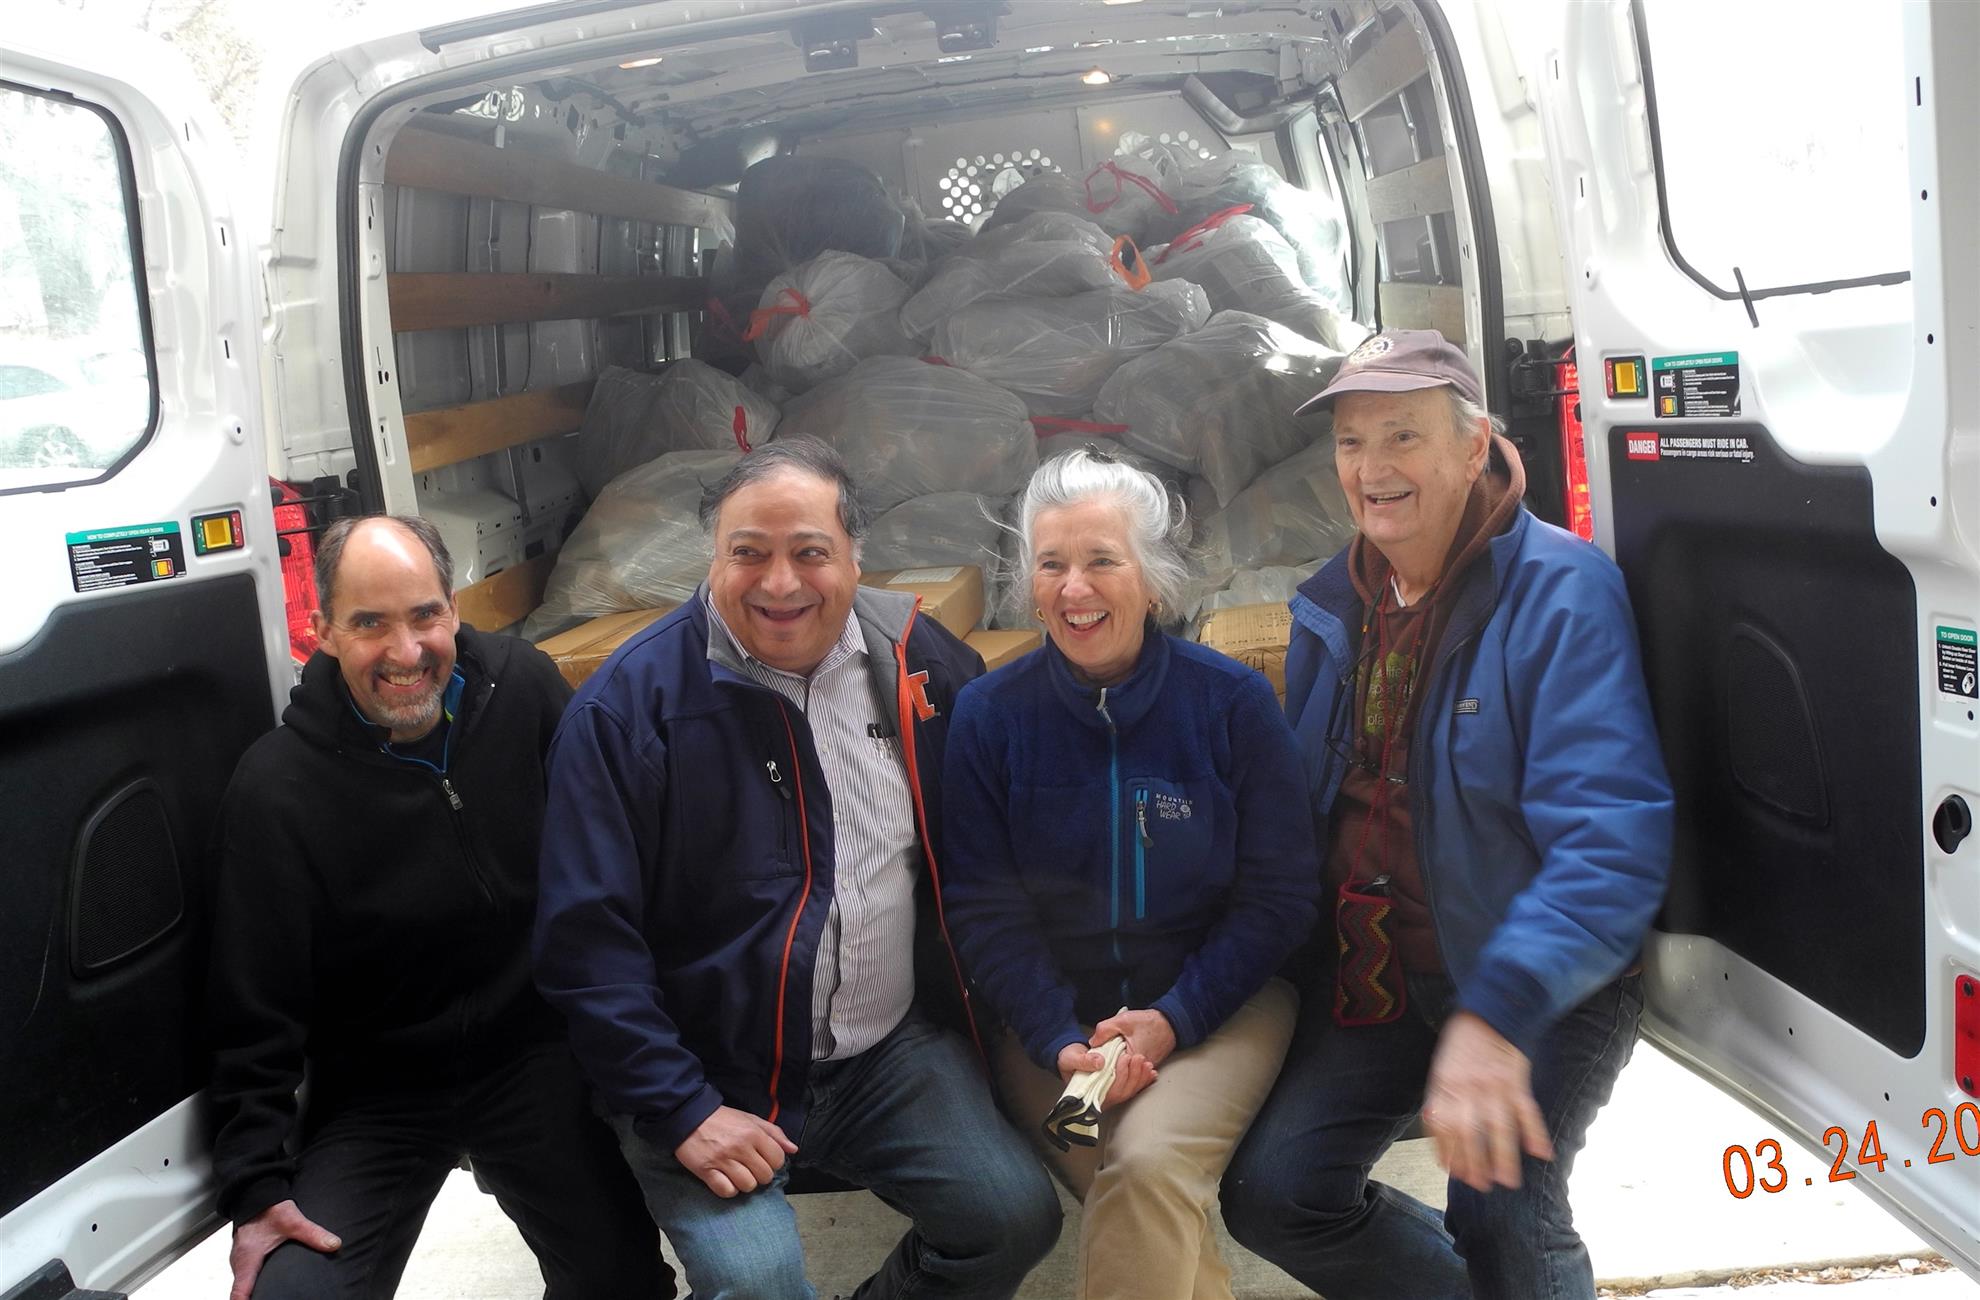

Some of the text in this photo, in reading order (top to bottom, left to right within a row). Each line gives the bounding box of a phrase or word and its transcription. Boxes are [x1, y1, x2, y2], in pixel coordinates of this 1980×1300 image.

[1628, 439, 1657, 454] DANGER
[1660, 437, 1669, 448] ALL
[1669, 437, 1702, 449] PASSENGERS
[1702, 438, 1716, 449] MUST
[1716, 438, 1729, 449] RIDE
[1729, 438, 1736, 449] IN
[1660, 448, 1682, 458] Passengers
[1947, 632, 1960, 641] OPEN
[1960, 634, 1974, 642] DOOR
[1156, 800, 1177, 813] HARD
[1160, 809, 1181, 821] WEAR
